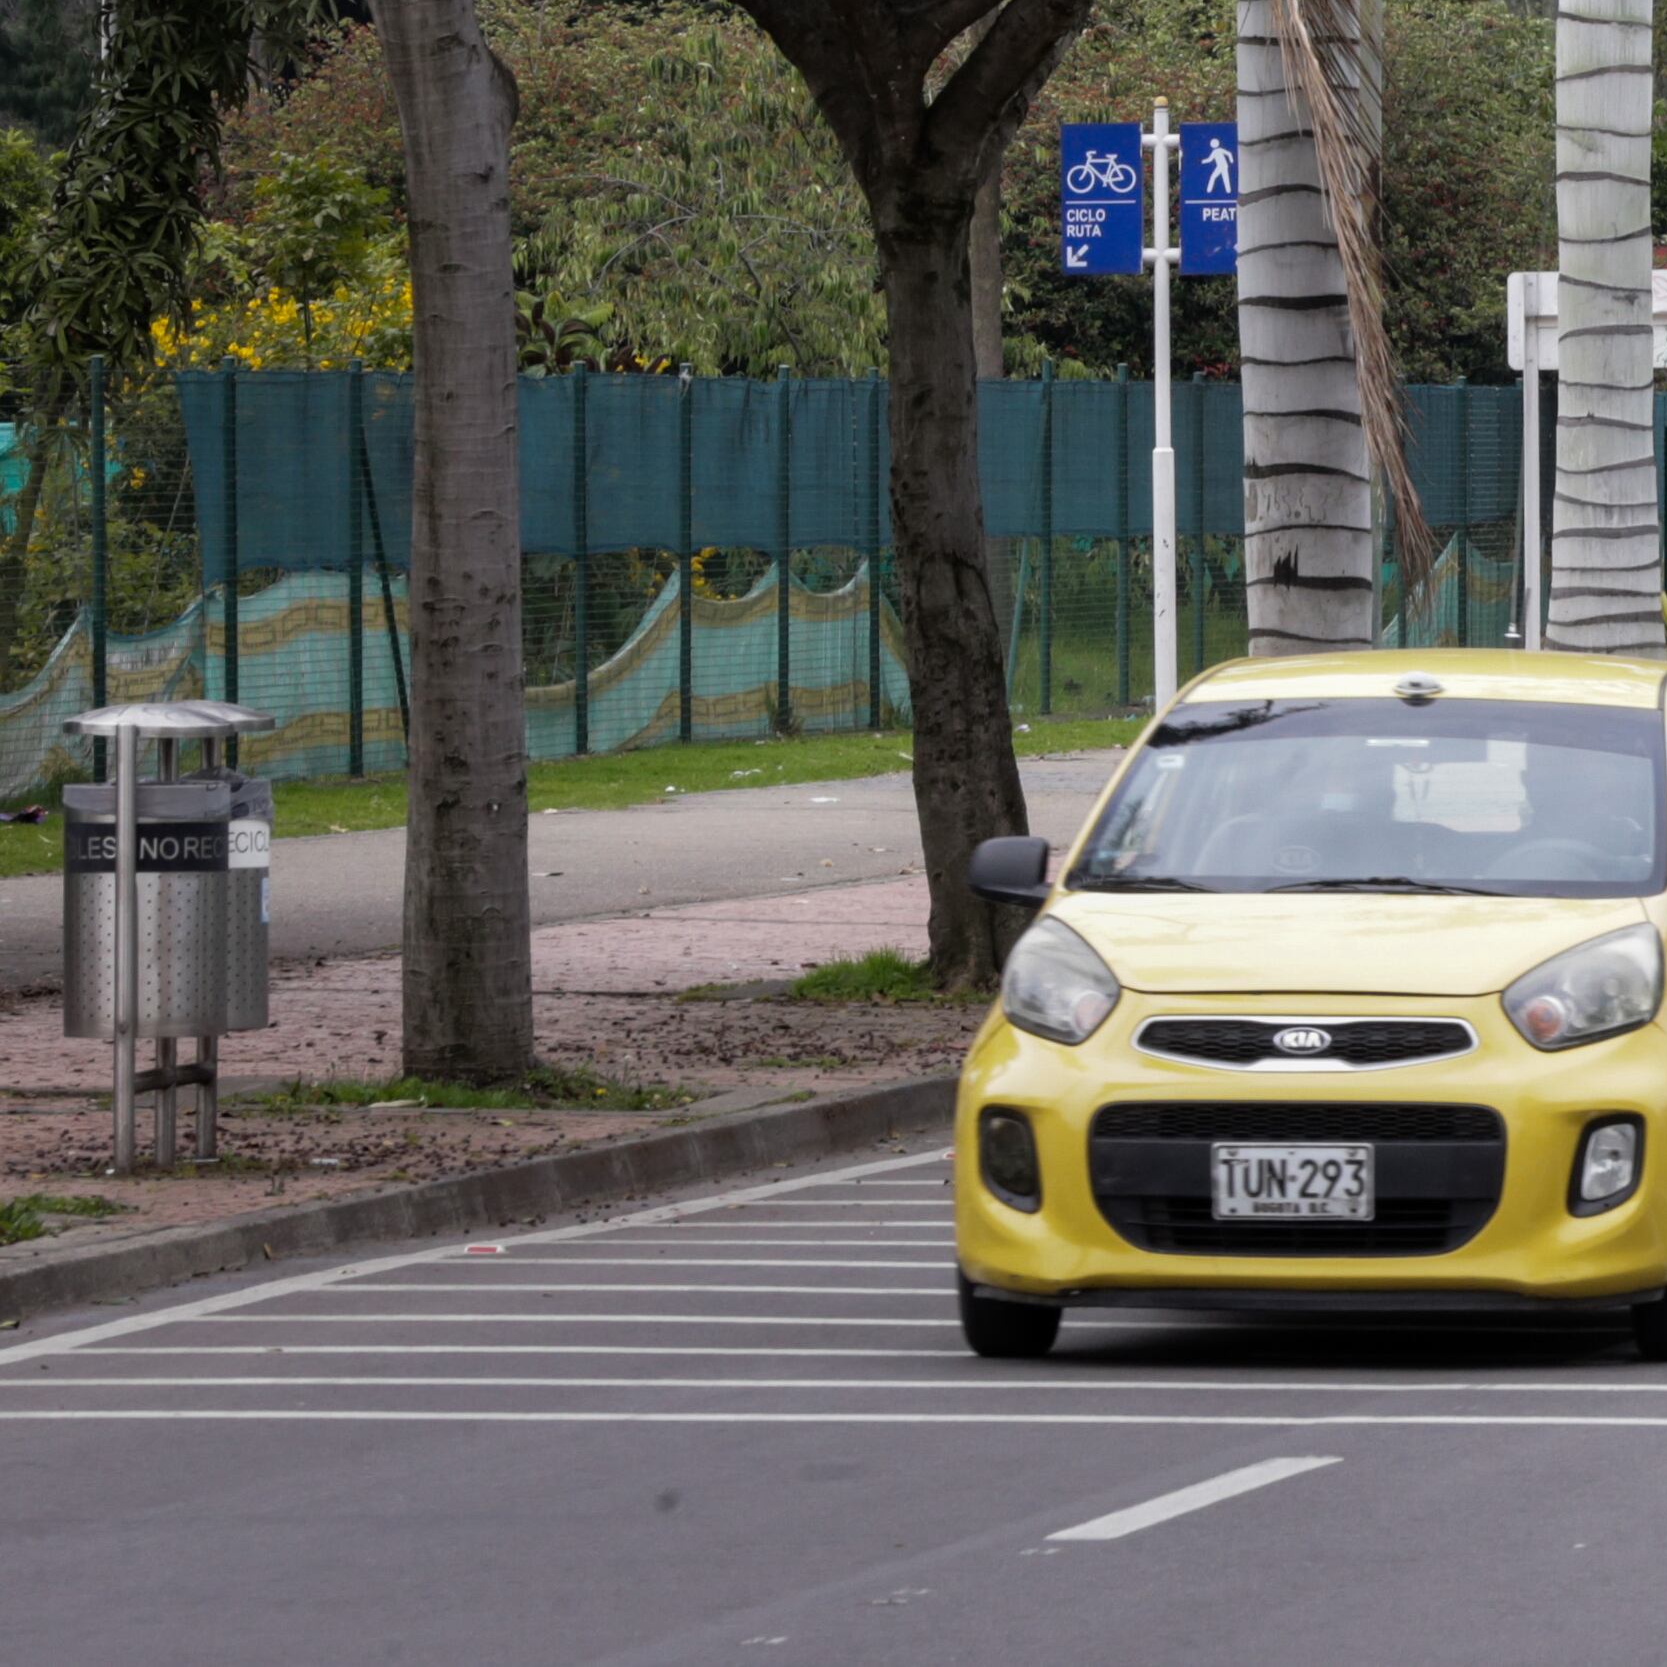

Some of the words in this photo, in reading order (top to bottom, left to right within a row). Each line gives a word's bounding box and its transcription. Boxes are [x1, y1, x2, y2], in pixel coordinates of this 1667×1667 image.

[1066, 209, 1106, 222] CICLO
[1066, 224, 1101, 237] RUTA
[139, 836, 180, 860] NO
[1283, 1031, 1321, 1048] KIA
[1221, 1159, 1365, 1199] TUN-293
